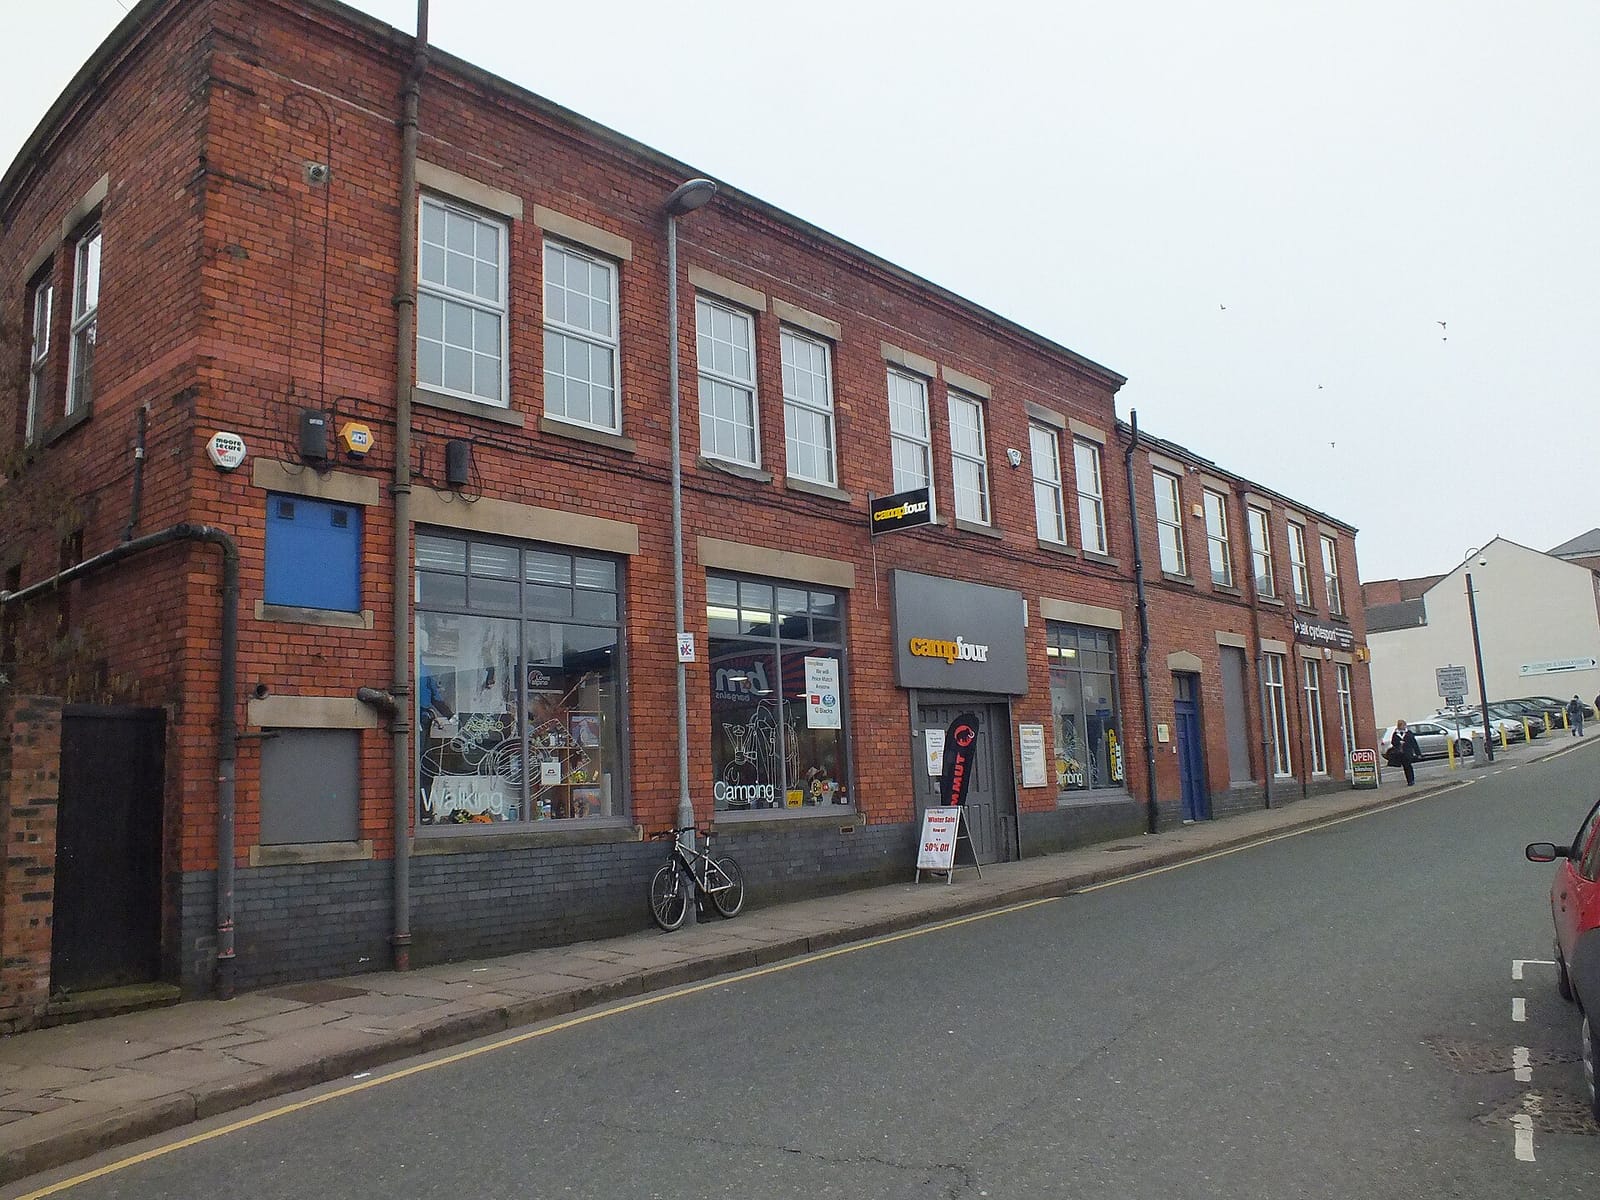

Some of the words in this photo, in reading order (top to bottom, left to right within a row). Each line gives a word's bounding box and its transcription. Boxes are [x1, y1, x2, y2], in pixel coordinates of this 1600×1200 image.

[215, 437, 242, 447] moore
[215, 442, 242, 452] secure
[874, 501, 928, 522] campfour
[910, 636, 989, 664] campfour
[1352, 752, 1373, 762] OPEN
[714, 780, 774, 803] Camping
[420, 786, 504, 815] Walking
[924, 843, 939, 852] 50%
[939, 843, 950, 852] Off
